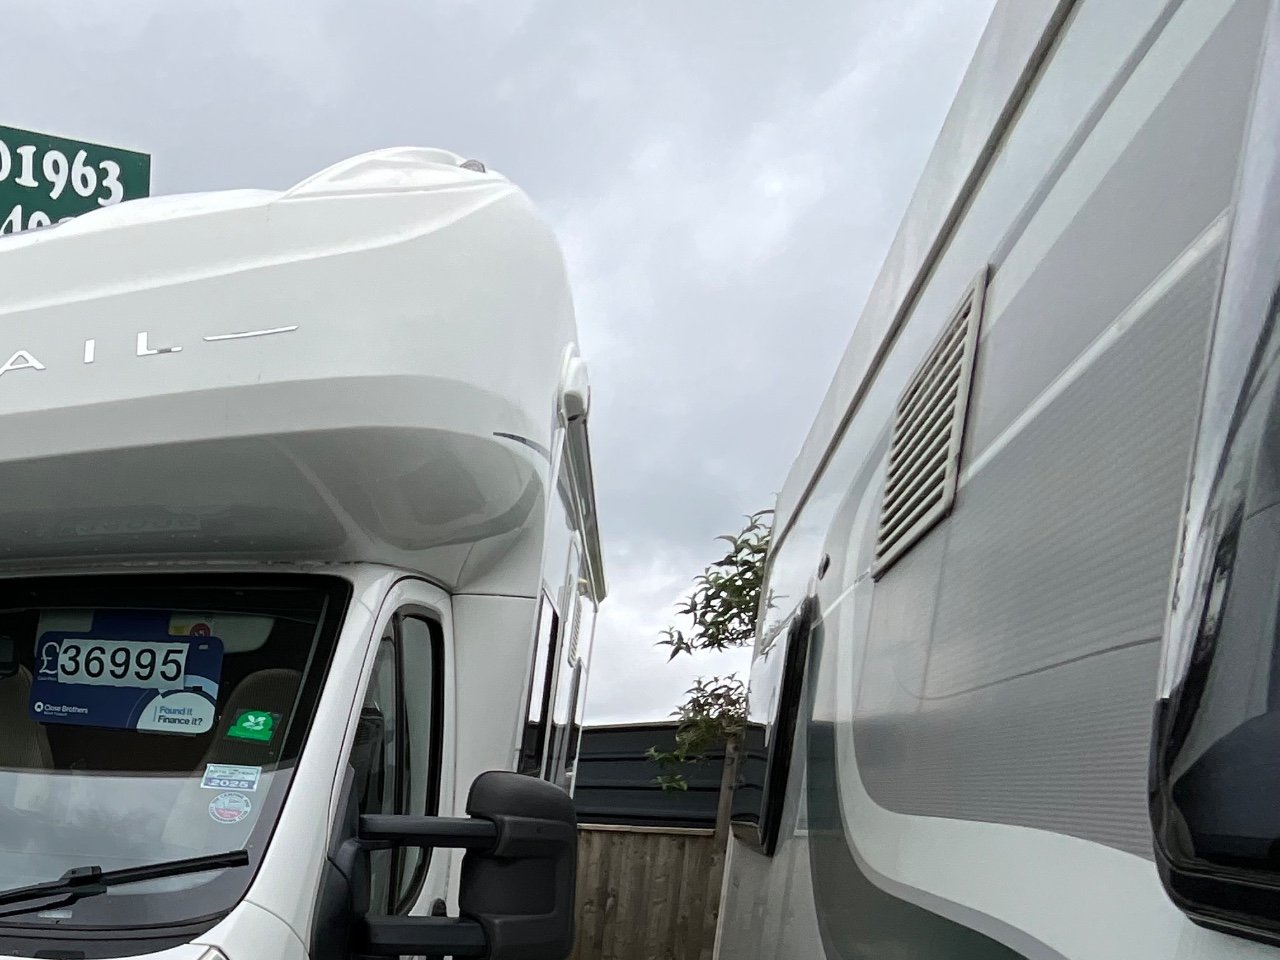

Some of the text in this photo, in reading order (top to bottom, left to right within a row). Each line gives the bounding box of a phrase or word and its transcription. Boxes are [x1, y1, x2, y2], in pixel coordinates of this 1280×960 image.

[62, 705, 88, 714] Brothers
[159, 706, 186, 715] Found
[158, 715, 203, 726] Finance it?
[209, 778, 249, 788] 2025
